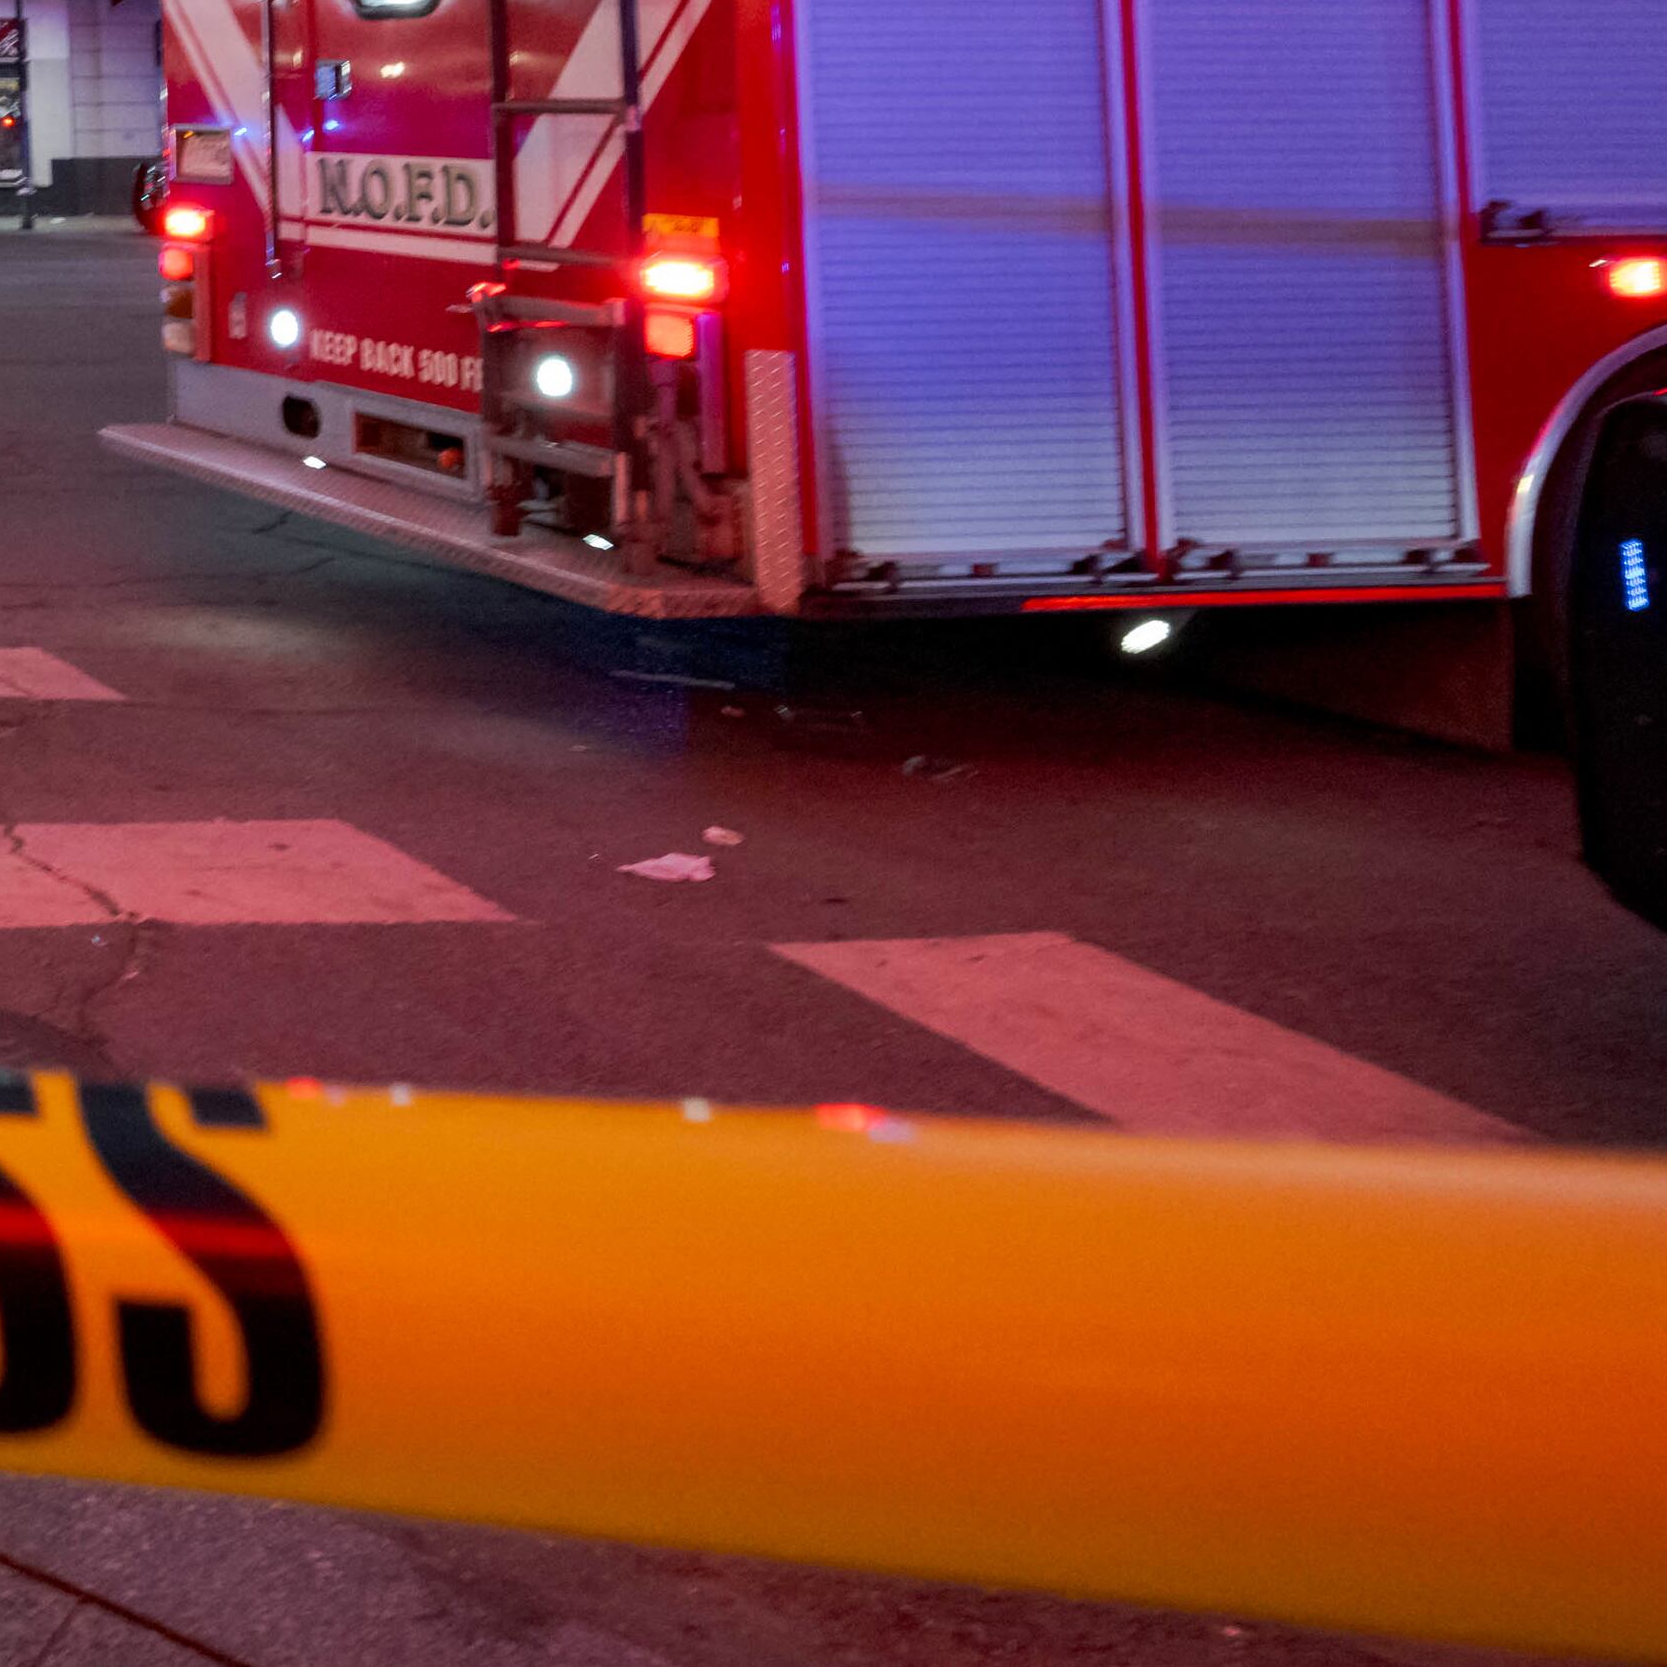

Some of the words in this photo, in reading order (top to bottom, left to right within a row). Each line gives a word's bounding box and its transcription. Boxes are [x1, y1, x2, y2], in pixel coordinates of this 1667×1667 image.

[319, 157, 496, 228] N.O.F.D.
[308, 328, 358, 366] KEEP
[360, 337, 415, 379] BACK
[418, 348, 459, 388] 500
